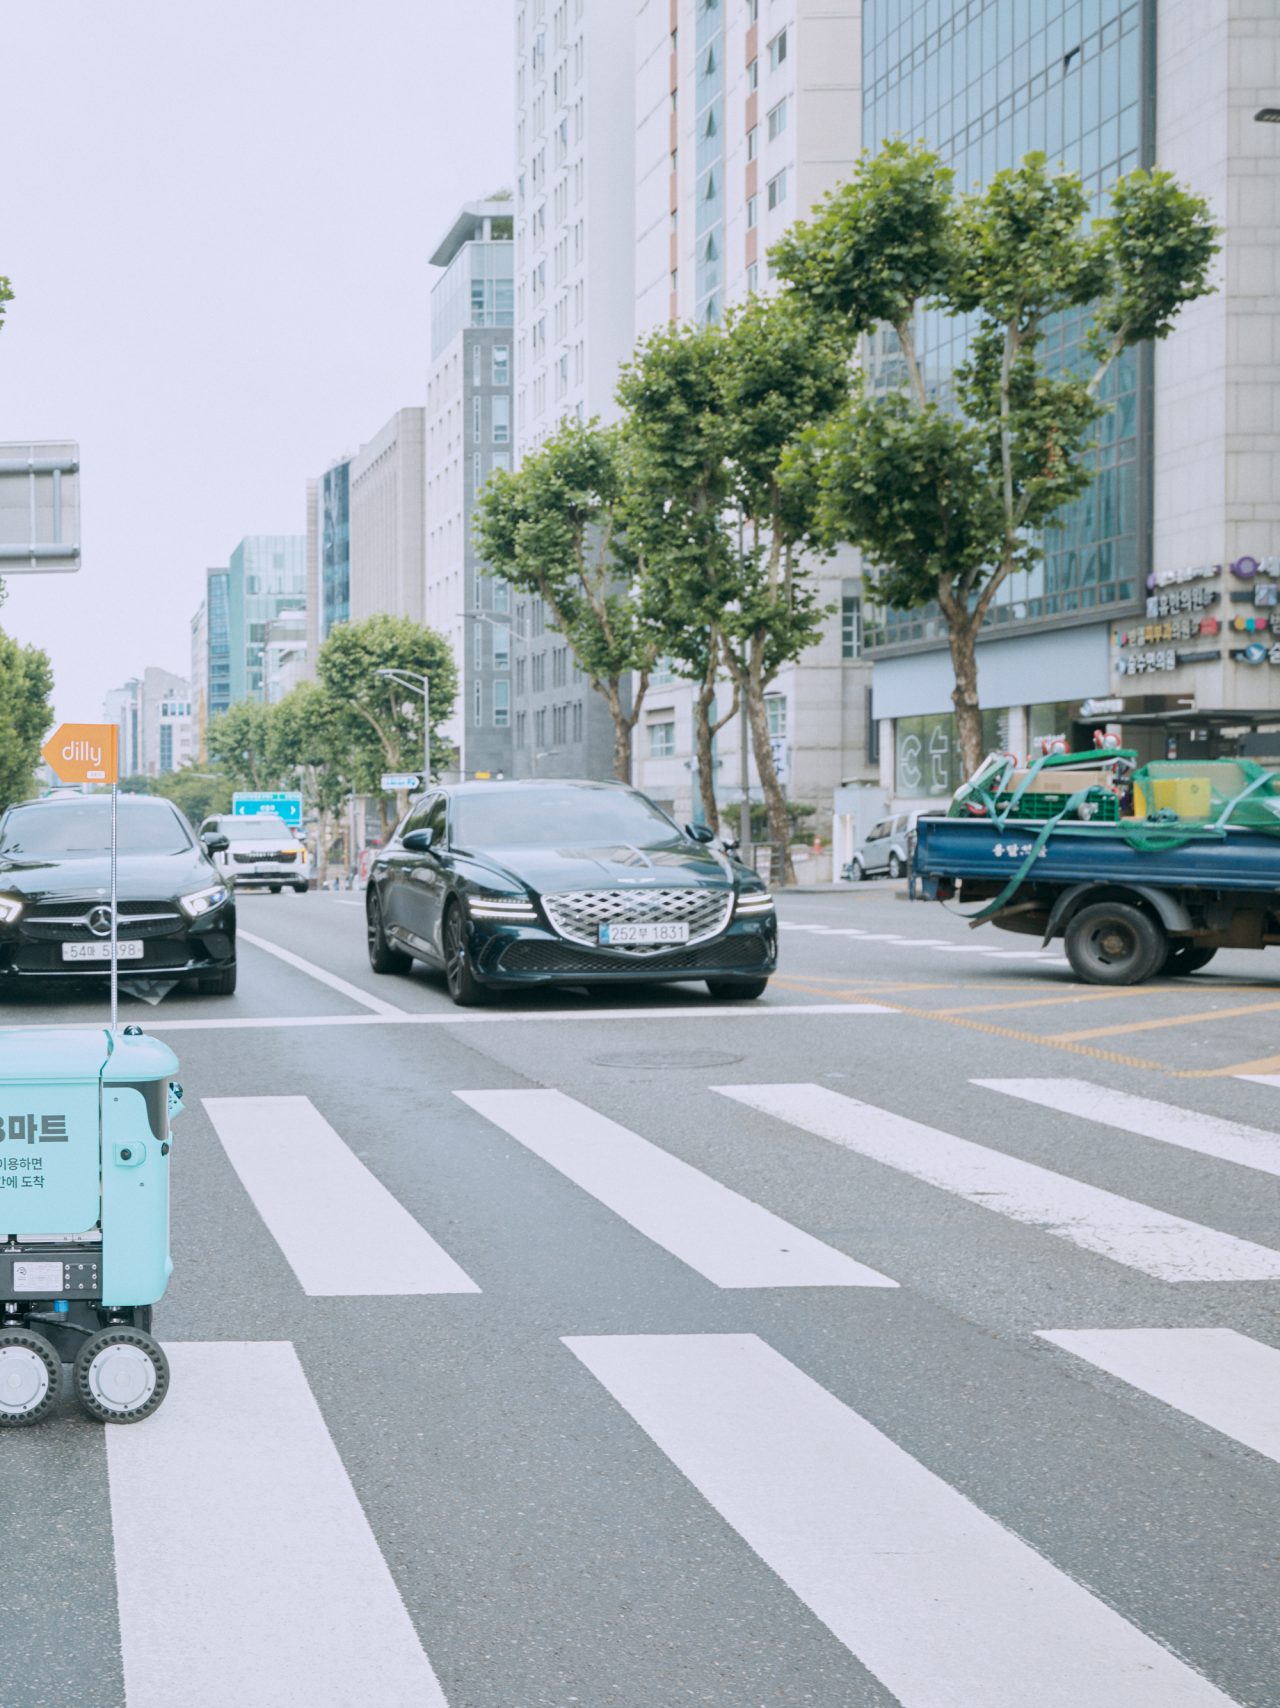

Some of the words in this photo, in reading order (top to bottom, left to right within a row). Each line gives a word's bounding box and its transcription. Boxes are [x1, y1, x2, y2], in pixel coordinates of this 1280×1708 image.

[62, 741, 101, 766] dilly
[653, 926, 683, 939] 1831
[102, 943, 136, 957] 598
[21, 1175, 45, 1188] 도착
